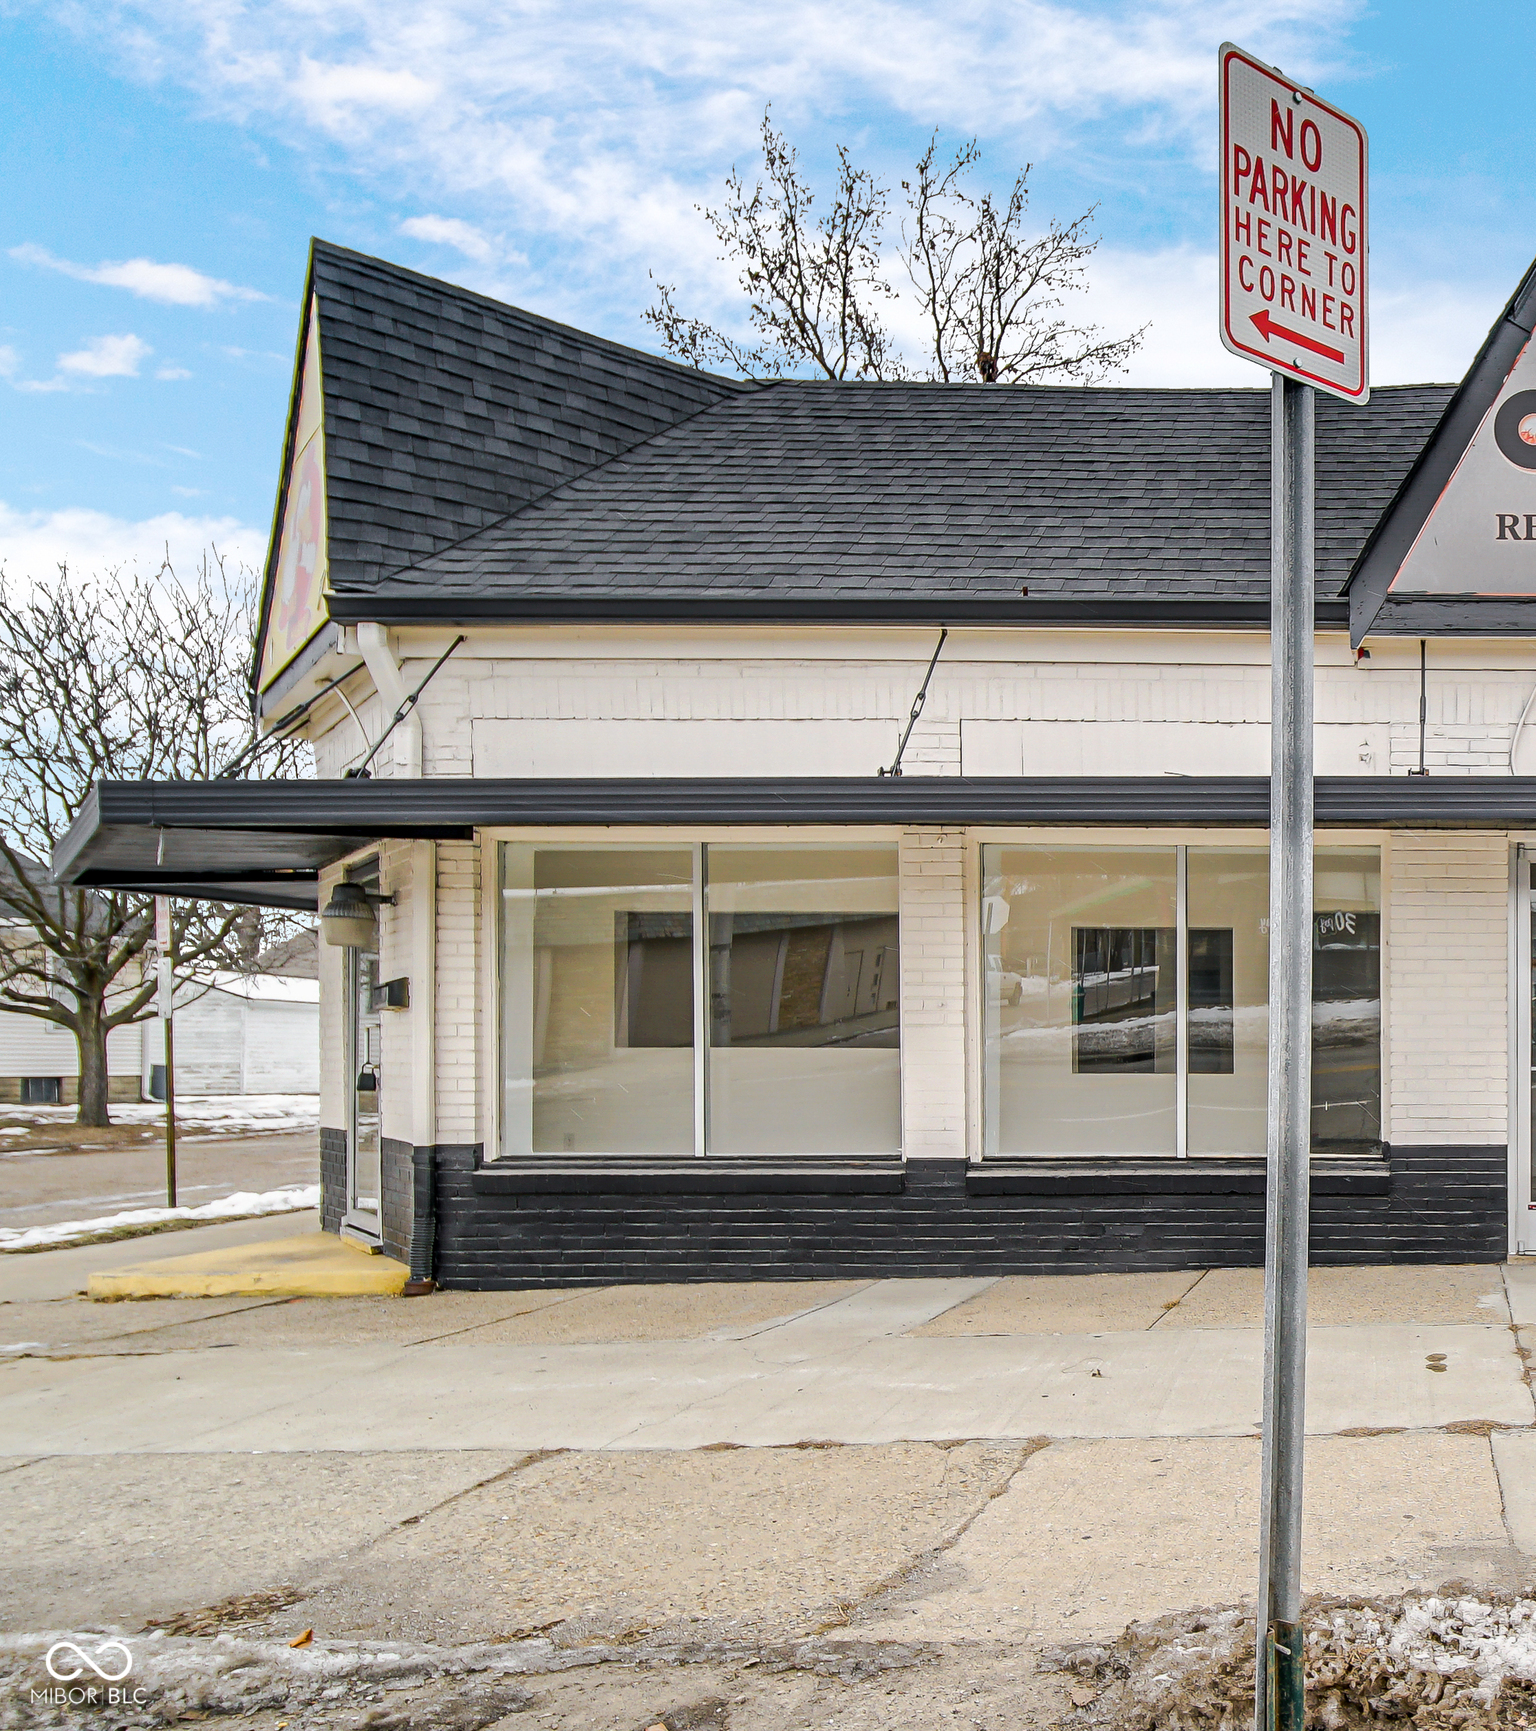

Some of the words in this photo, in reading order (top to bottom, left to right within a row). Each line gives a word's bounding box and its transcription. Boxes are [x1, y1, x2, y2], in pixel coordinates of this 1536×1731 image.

[1270, 97, 1322, 173] NO
[1233, 143, 1357, 255] PARKING
[1235, 205, 1311, 276] HERE
[1324, 251, 1356, 296] TO
[1238, 254, 1355, 339] CORNER
